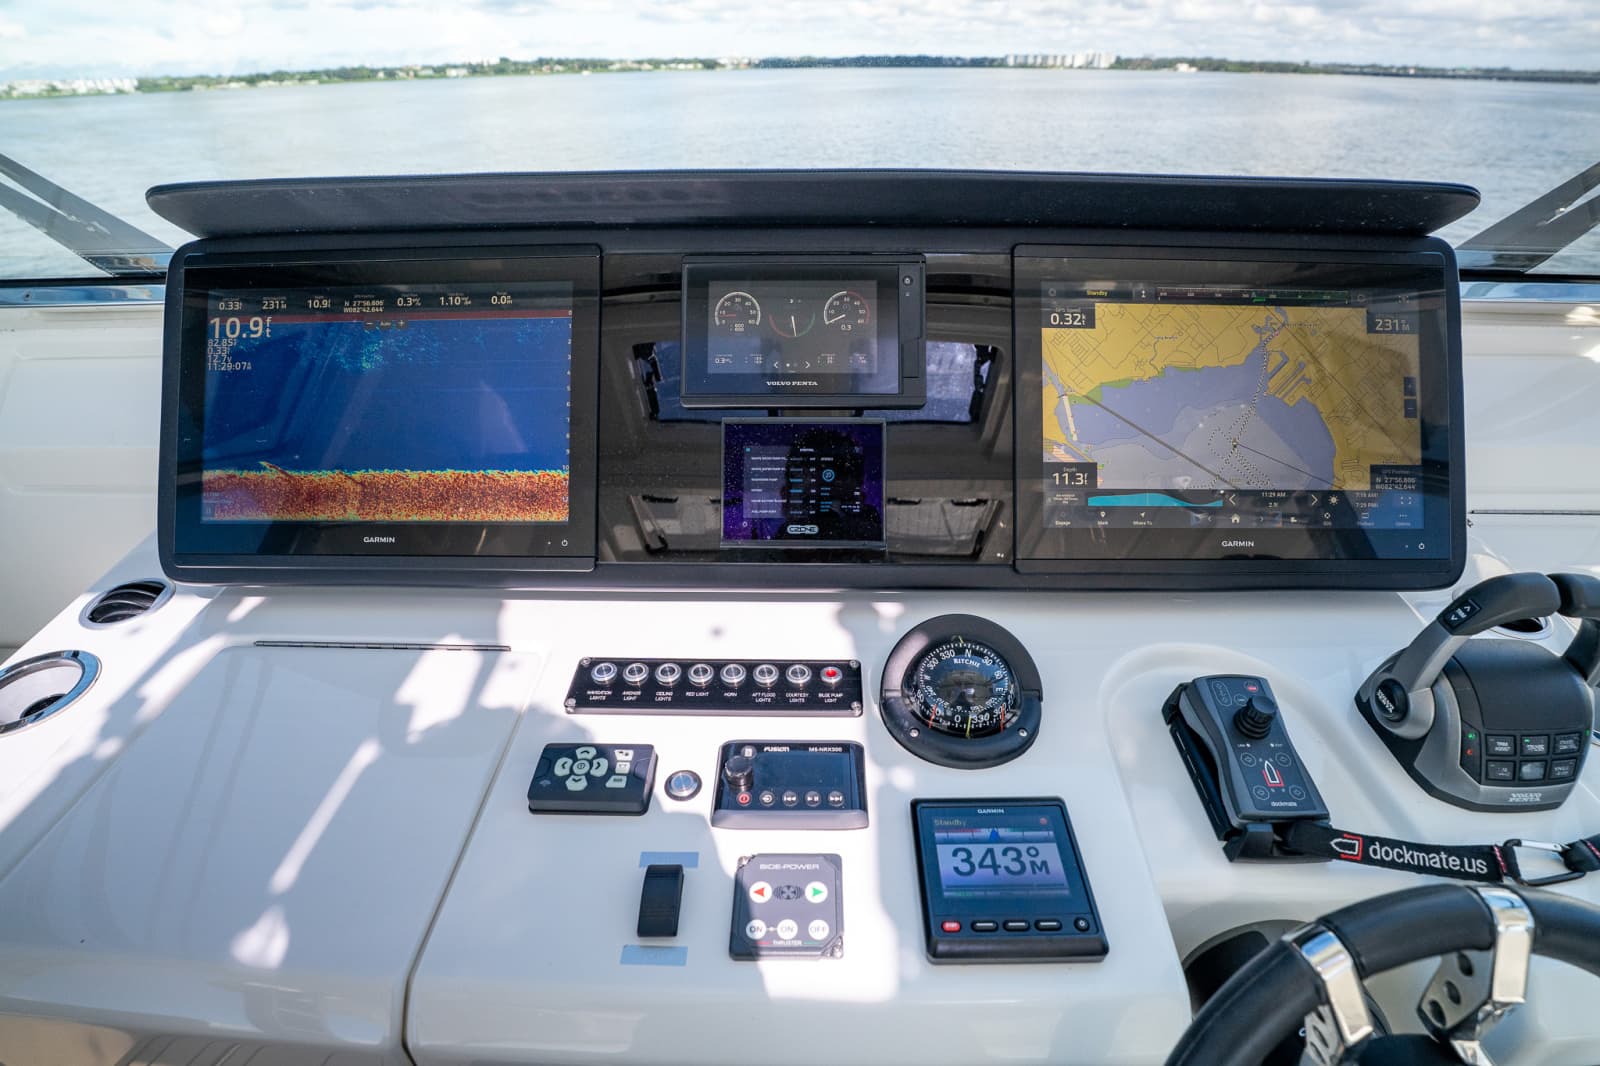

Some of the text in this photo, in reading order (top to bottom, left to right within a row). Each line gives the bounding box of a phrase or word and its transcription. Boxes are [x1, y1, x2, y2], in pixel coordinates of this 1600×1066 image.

[939, 649, 956, 660] 330
[965, 649, 971, 657] N
[953, 658, 981, 668] RITCHIE
[1369, 841, 1488, 874] dockmate.us
